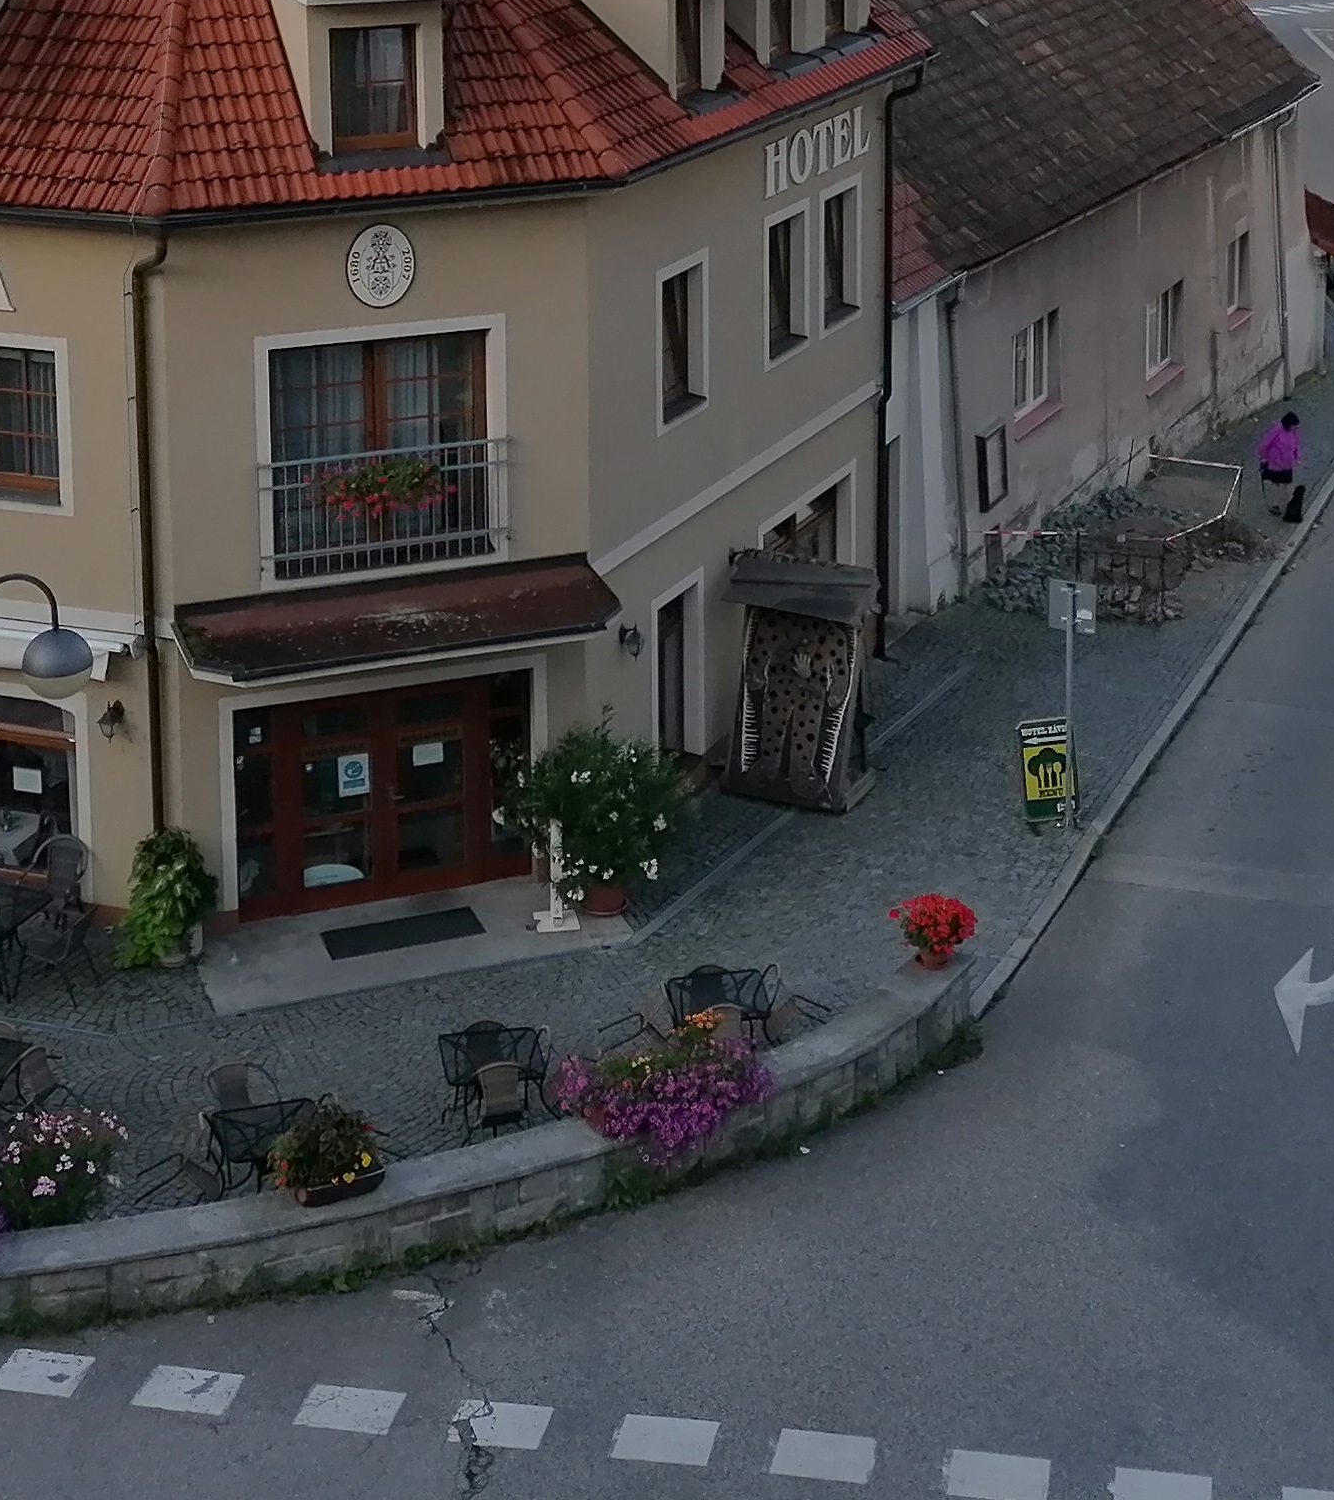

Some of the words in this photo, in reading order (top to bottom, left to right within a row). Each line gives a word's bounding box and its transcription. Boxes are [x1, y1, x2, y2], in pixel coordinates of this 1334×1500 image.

[765, 105, 870, 200] HOTEL
[350, 251, 360, 283] 1680
[402, 247, 412, 281] 2007
[1021, 726, 1047, 736] HOTEL
